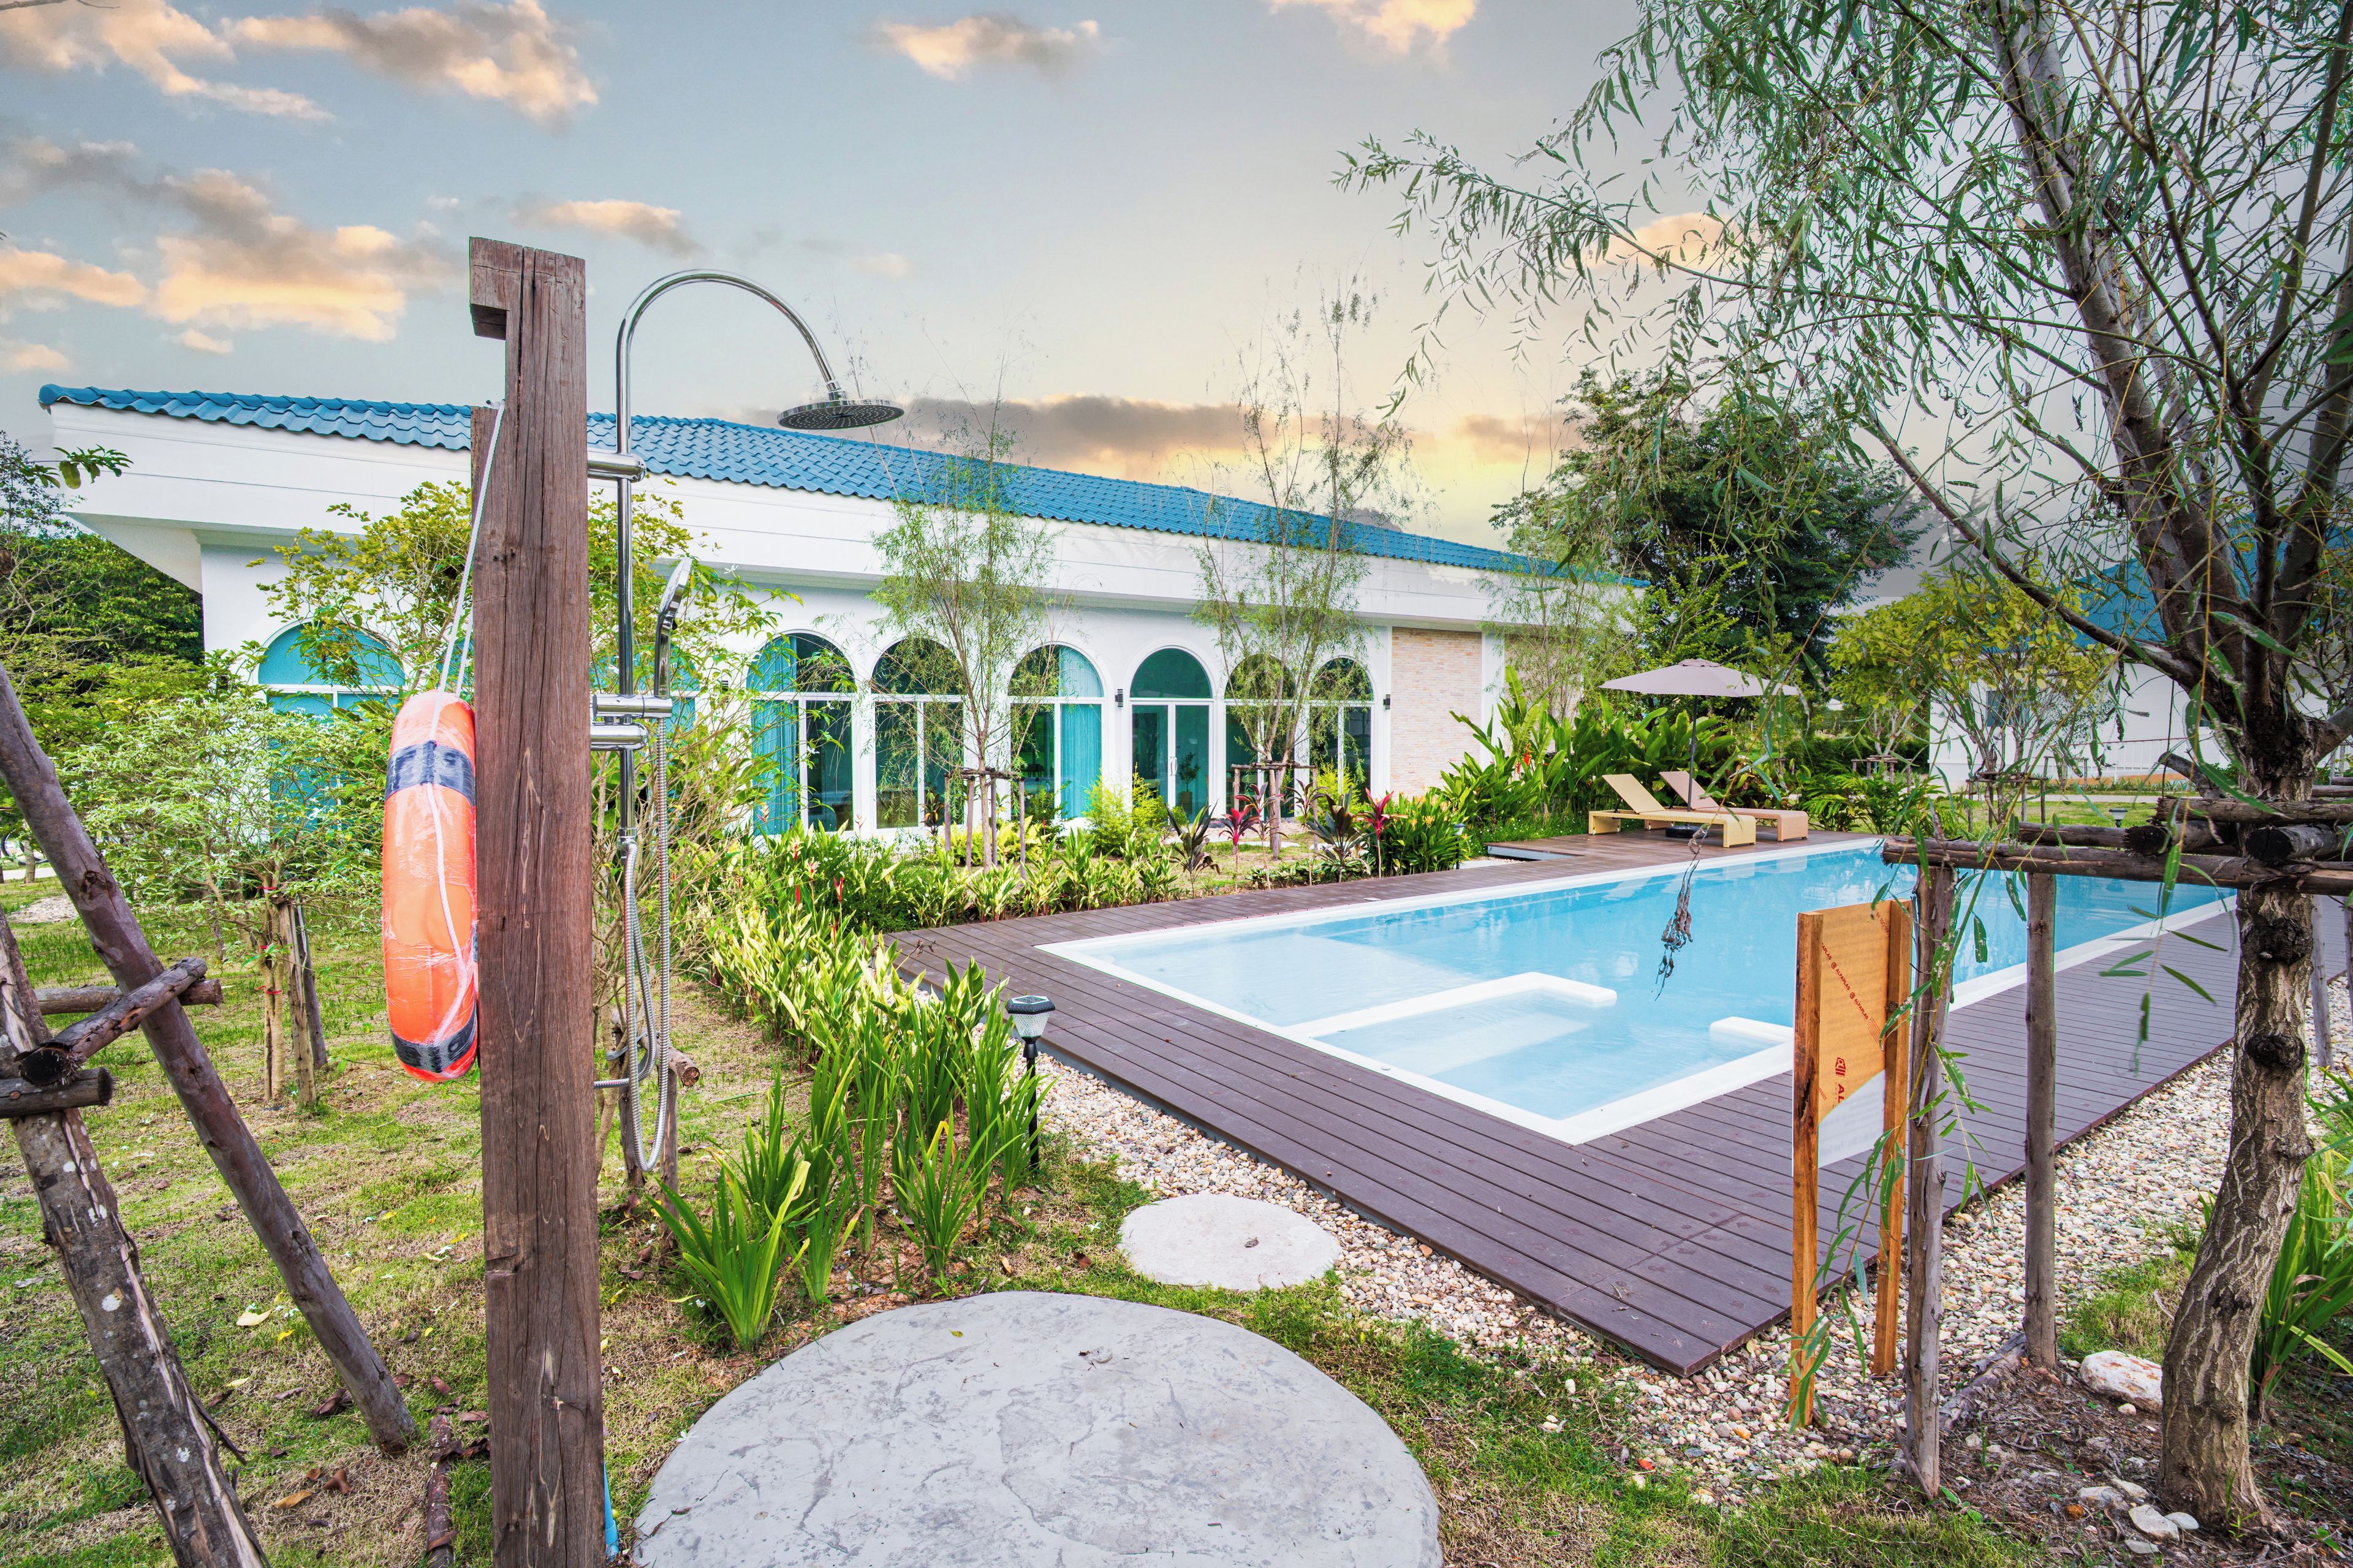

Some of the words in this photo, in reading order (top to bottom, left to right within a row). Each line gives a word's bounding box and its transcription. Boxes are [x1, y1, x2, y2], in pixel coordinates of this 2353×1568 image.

[1836, 969, 1851, 991] ALFAPLAS
[1854, 999, 1869, 1020] ALFAPLAS
[1838, 1083, 1844, 1104] AL
